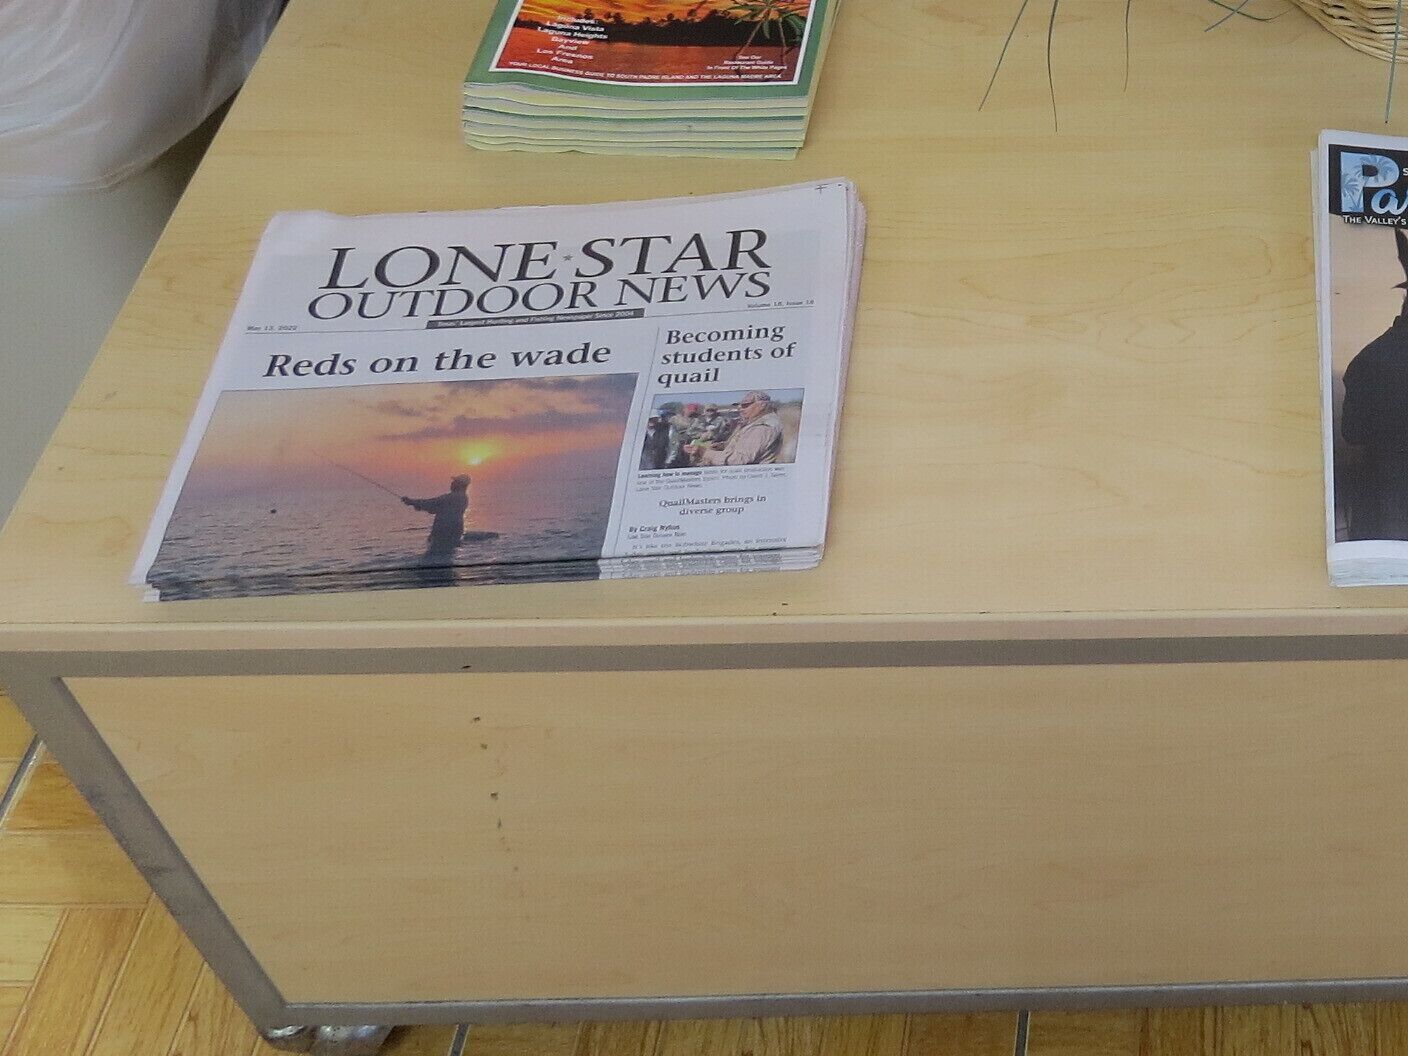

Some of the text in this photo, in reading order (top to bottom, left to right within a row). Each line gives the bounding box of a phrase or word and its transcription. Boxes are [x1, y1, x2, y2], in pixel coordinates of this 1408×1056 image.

[537, 26, 608, 40] Laguna Heights
[318, 228, 772, 290] LONE STAR
[308, 271, 771, 320] OUTDOOR NEWS
[666, 325, 786, 344] Becoming
[262, 342, 612, 378] Reds on the wade
[661, 342, 797, 364] students of
[657, 367, 720, 389] quail
[659, 494, 766, 508] QuailMasters brings in
[679, 506, 744, 516] diverse group
